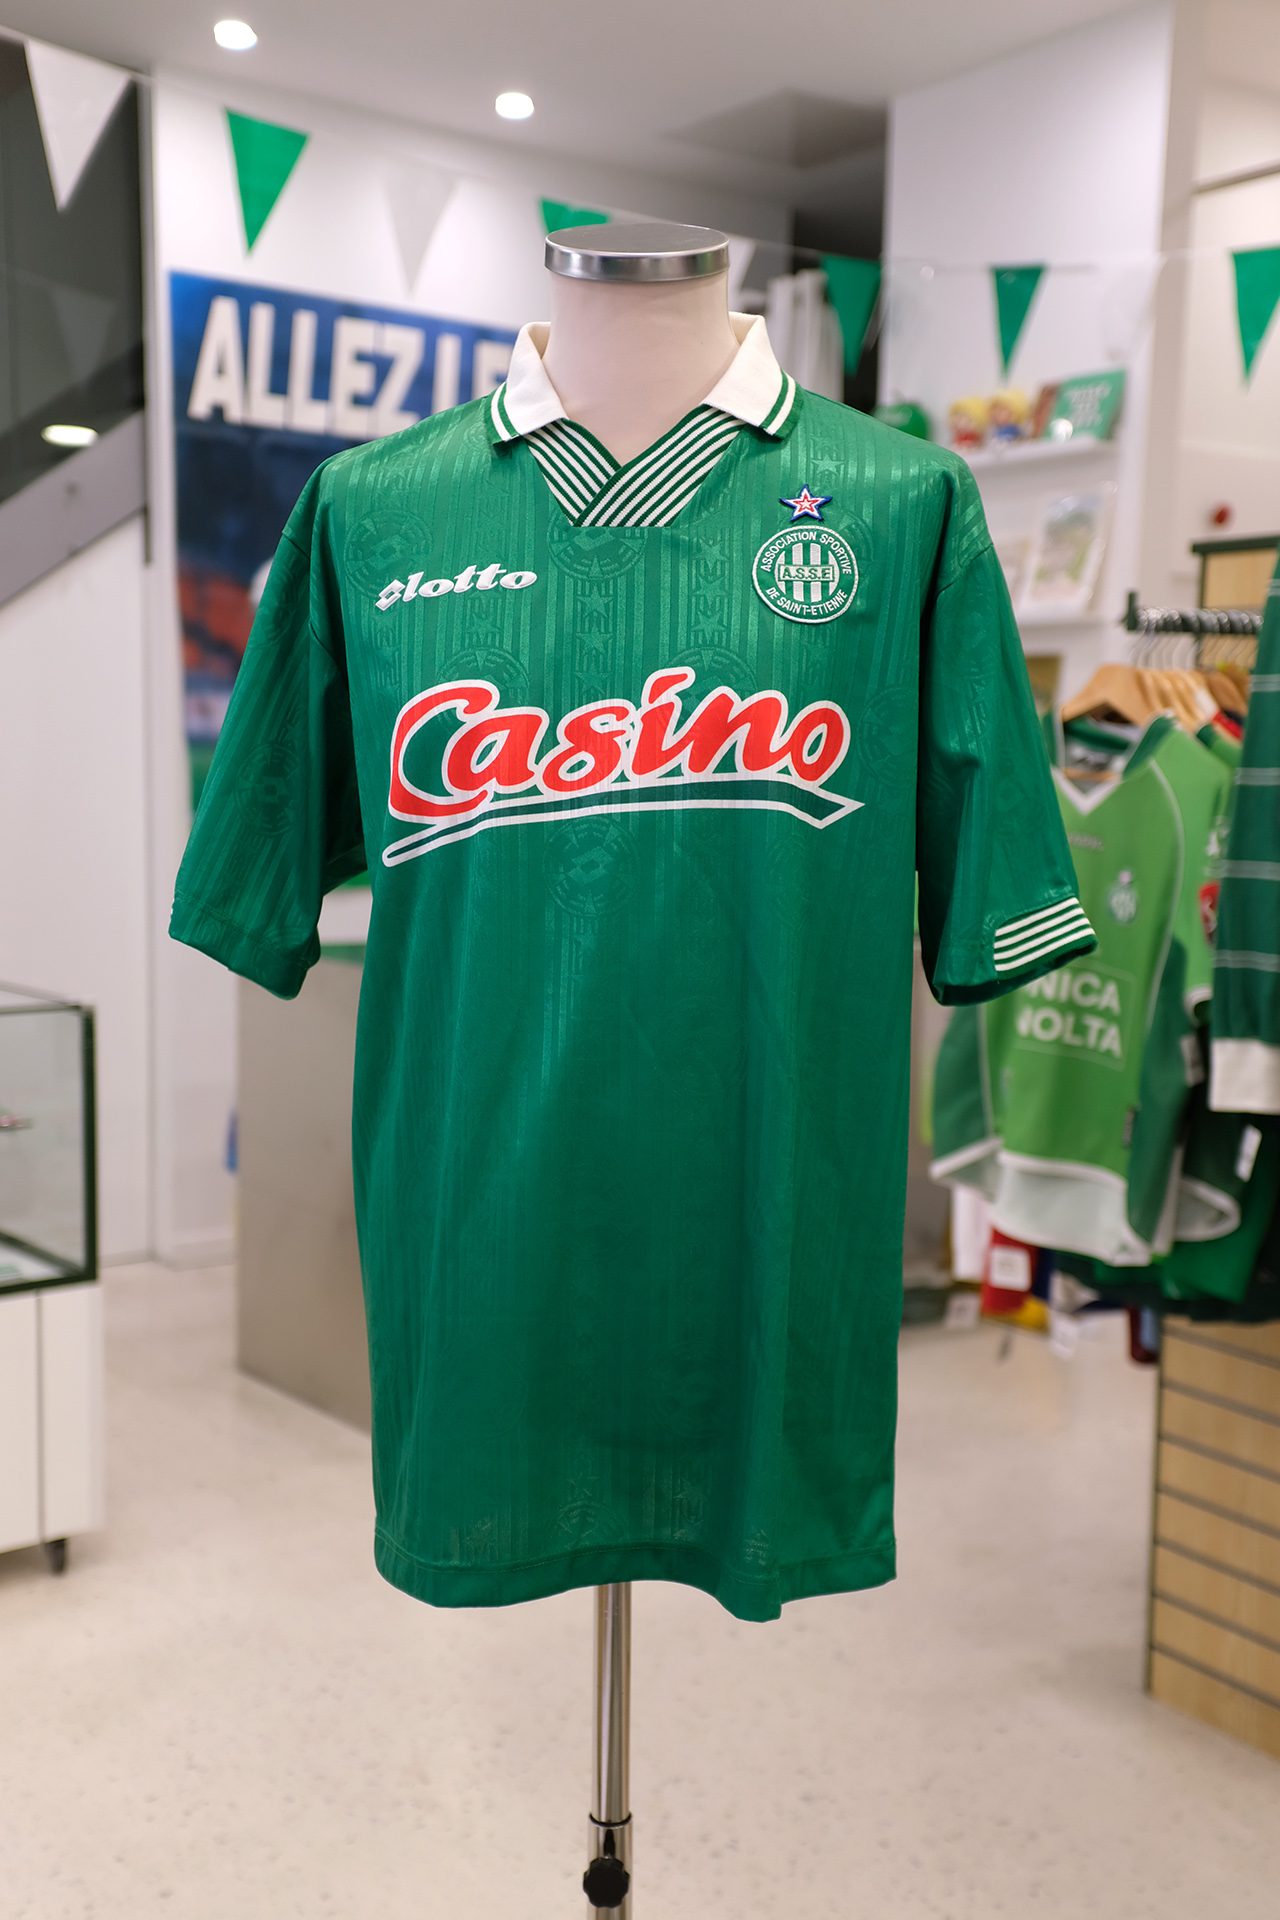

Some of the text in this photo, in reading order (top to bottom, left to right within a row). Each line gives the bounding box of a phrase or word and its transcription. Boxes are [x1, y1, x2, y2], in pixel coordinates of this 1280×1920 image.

[188, 295, 426, 440] ALLEZ
[760, 531, 852, 575] ASSOCIATION SPORTIVE
[402, 563, 538, 602] lotto
[765, 586, 848, 616] DE SAINT-ETIENNE
[388, 666, 852, 824] Casino
[1024, 970, 1121, 1016] NICA
